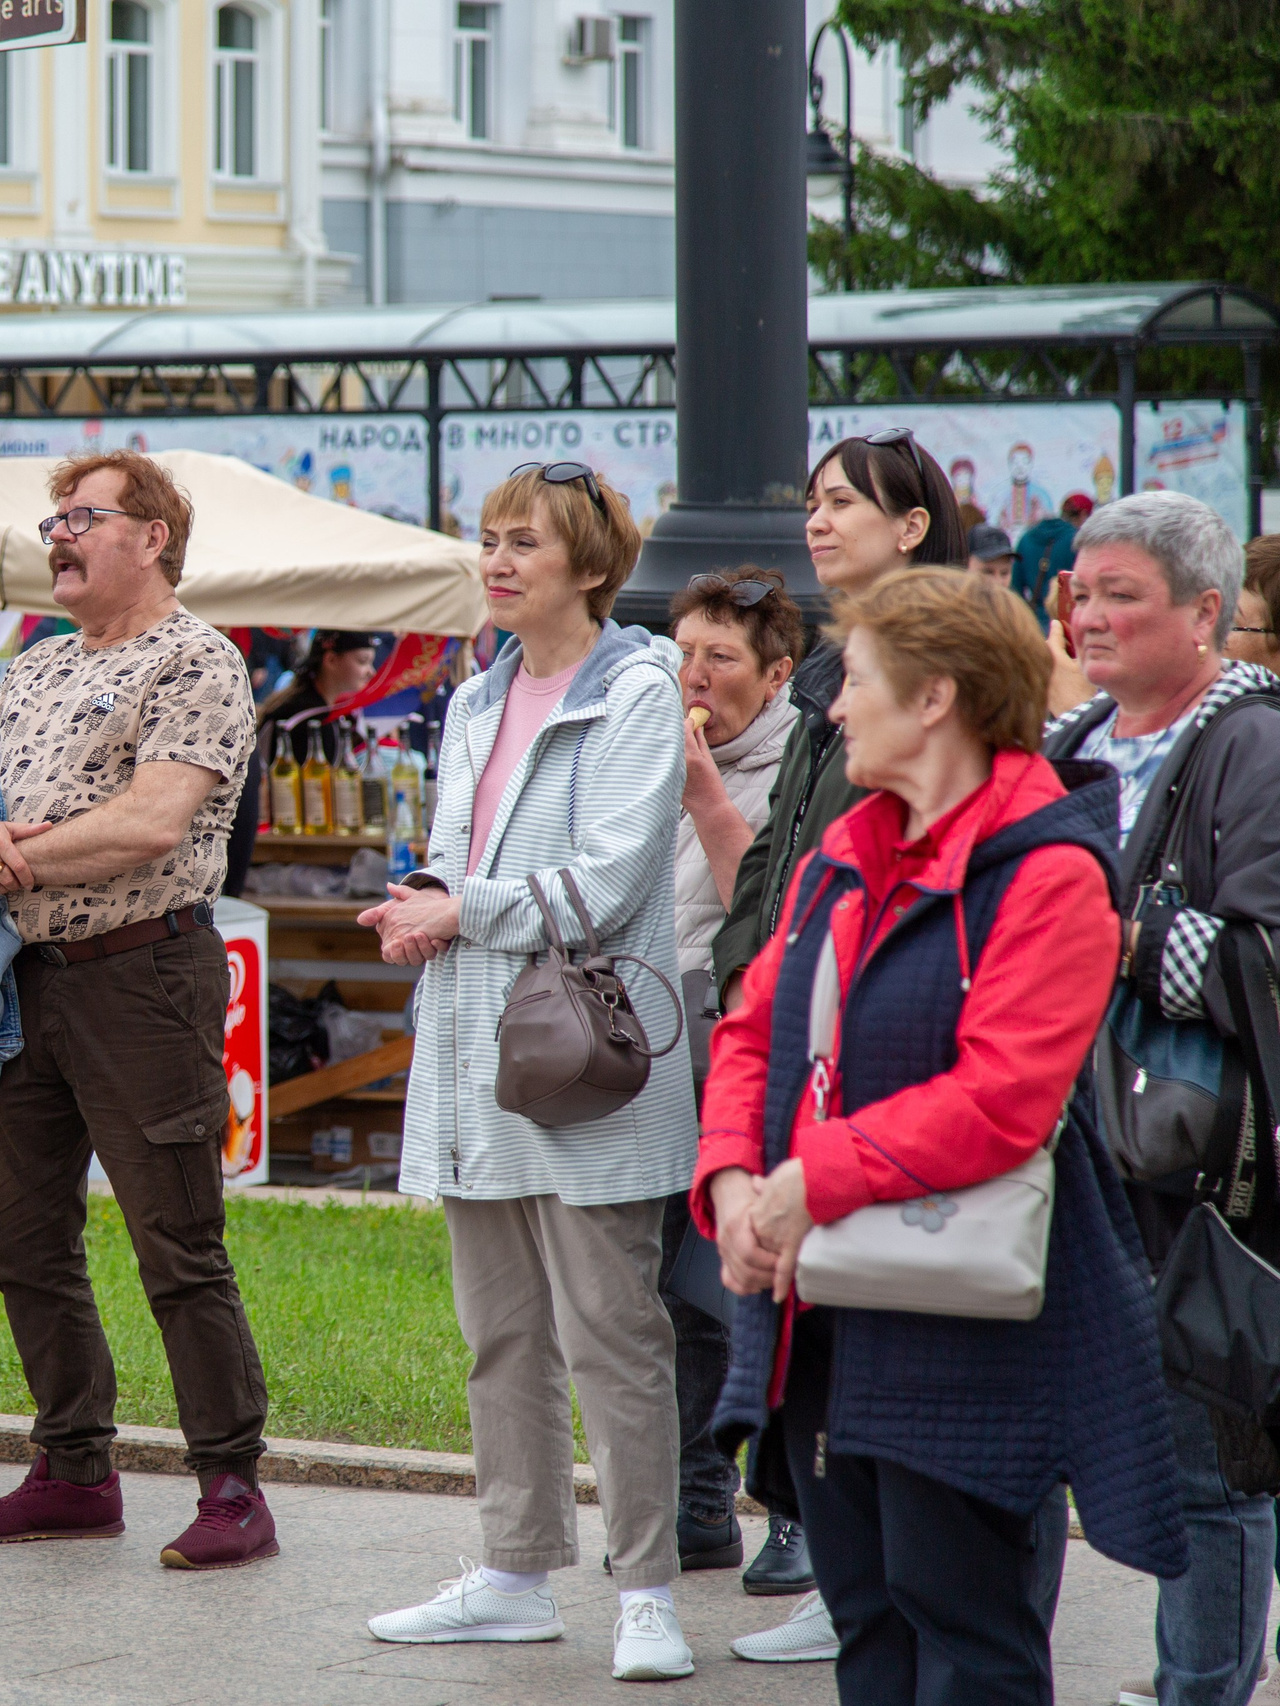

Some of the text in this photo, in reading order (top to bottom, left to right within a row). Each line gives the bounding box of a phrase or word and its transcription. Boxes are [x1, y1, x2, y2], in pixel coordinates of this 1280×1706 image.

[17, 249, 187, 306] ANYTIME
[475, 420, 582, 449] МНОГО
[613, 420, 677, 449] СТР
[91, 699, 115, 712] adidas
